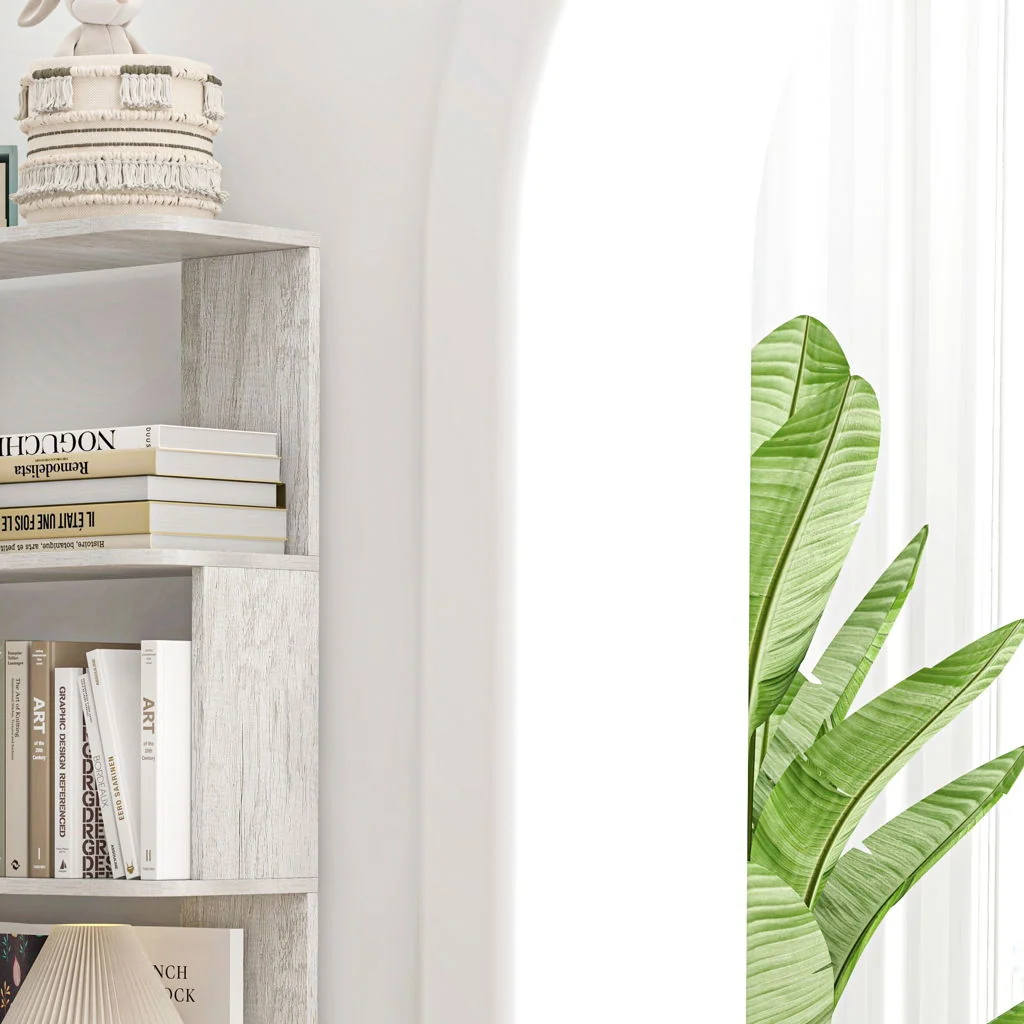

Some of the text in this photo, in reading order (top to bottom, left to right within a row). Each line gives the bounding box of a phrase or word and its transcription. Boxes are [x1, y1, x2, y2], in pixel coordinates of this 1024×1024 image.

[14, 461, 89, 478] Remodelista
[1, 515, 13, 532] LE
[15, 514, 35, 531] FOIS
[37, 513, 56, 530] UNE
[59, 512, 84, 531] ÉTAIT
[88, 511, 95, 527] IL
[33, 697, 46, 735] ART
[142, 697, 155, 735] ART
[94, 755, 109, 809] BORDEAUX
[107, 756, 125, 821] EERO SAARINEN
